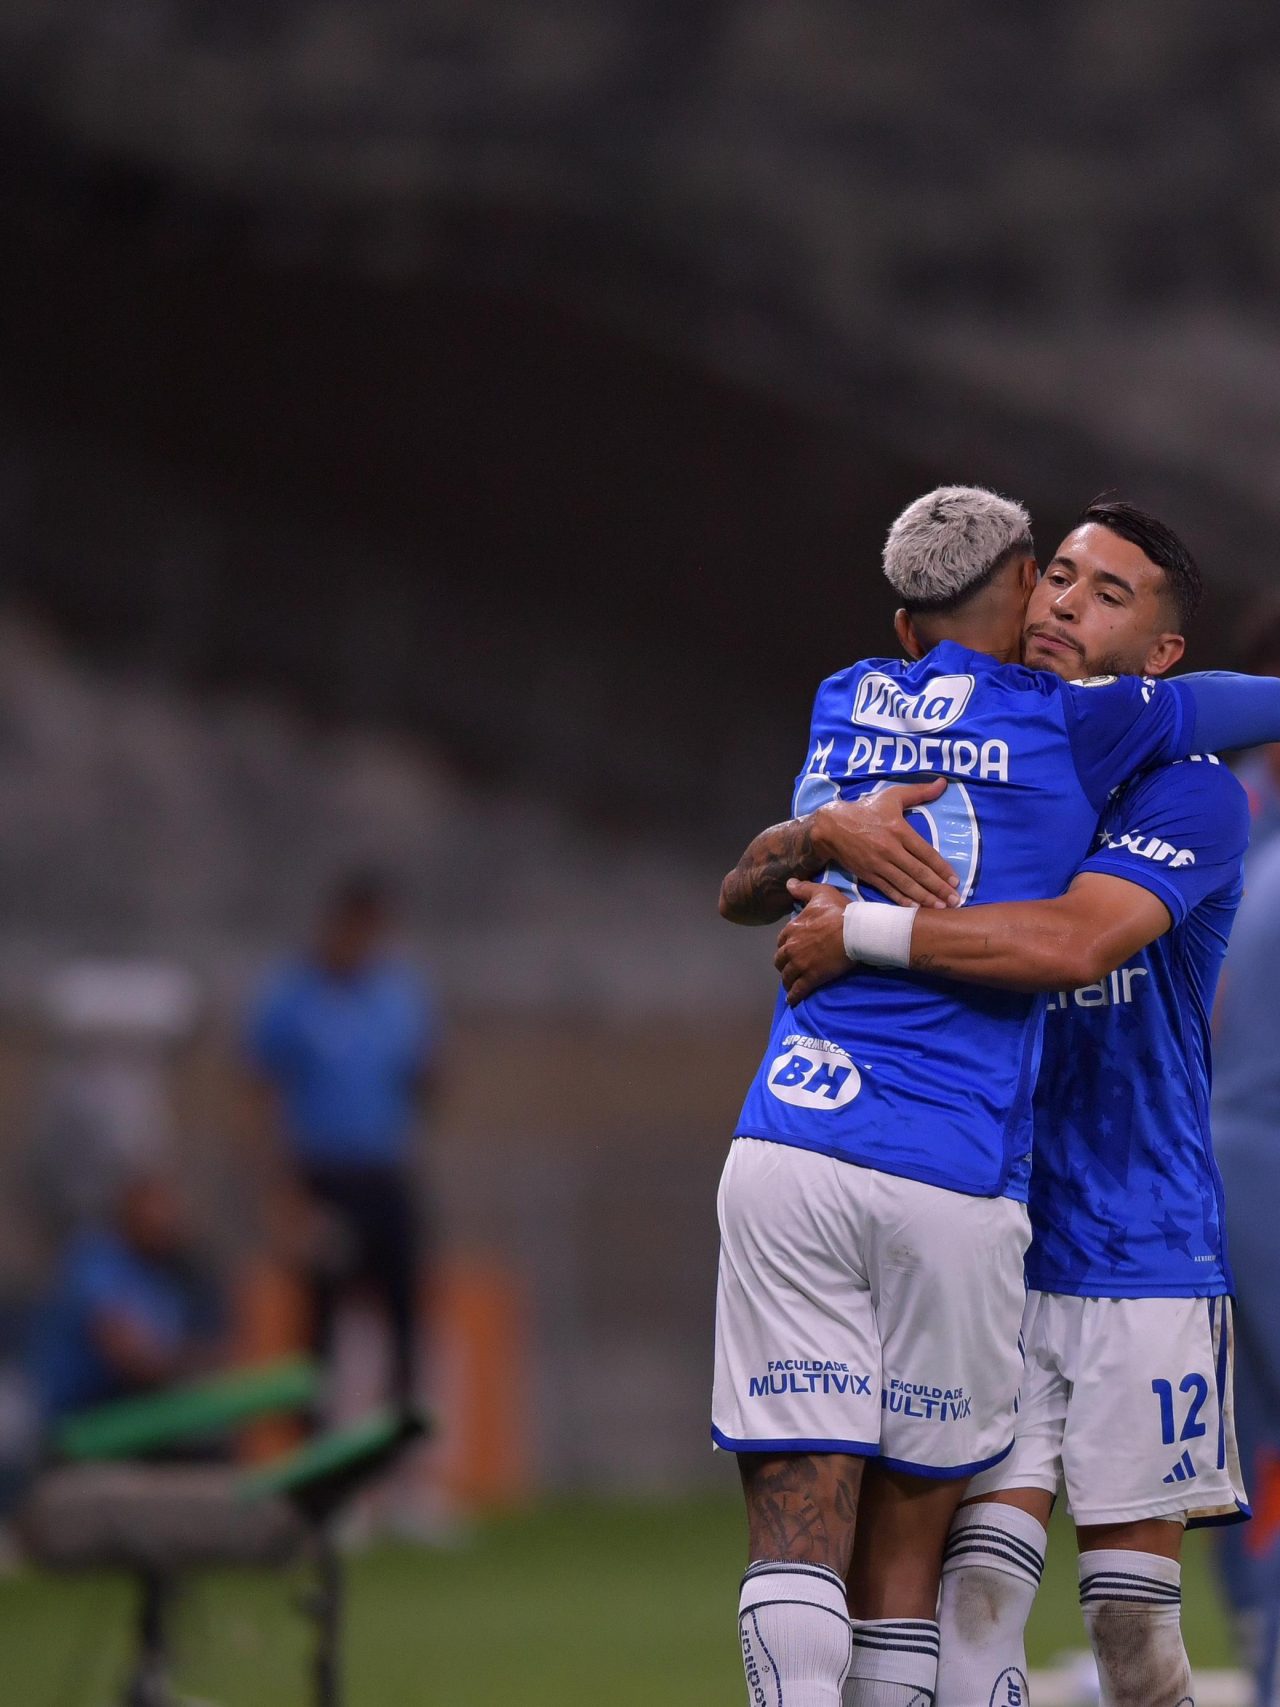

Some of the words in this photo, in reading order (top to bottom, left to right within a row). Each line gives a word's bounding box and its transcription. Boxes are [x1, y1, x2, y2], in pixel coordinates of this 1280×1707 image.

[844, 736, 1009, 783] PEREIRA
[771, 1054, 852, 1100] BH
[767, 1359, 849, 1373] FACULDADE
[748, 1372, 872, 1398] MULTIVIX
[890, 1378, 964, 1400] FACULDADE
[1151, 1372, 1209, 1446] 12
